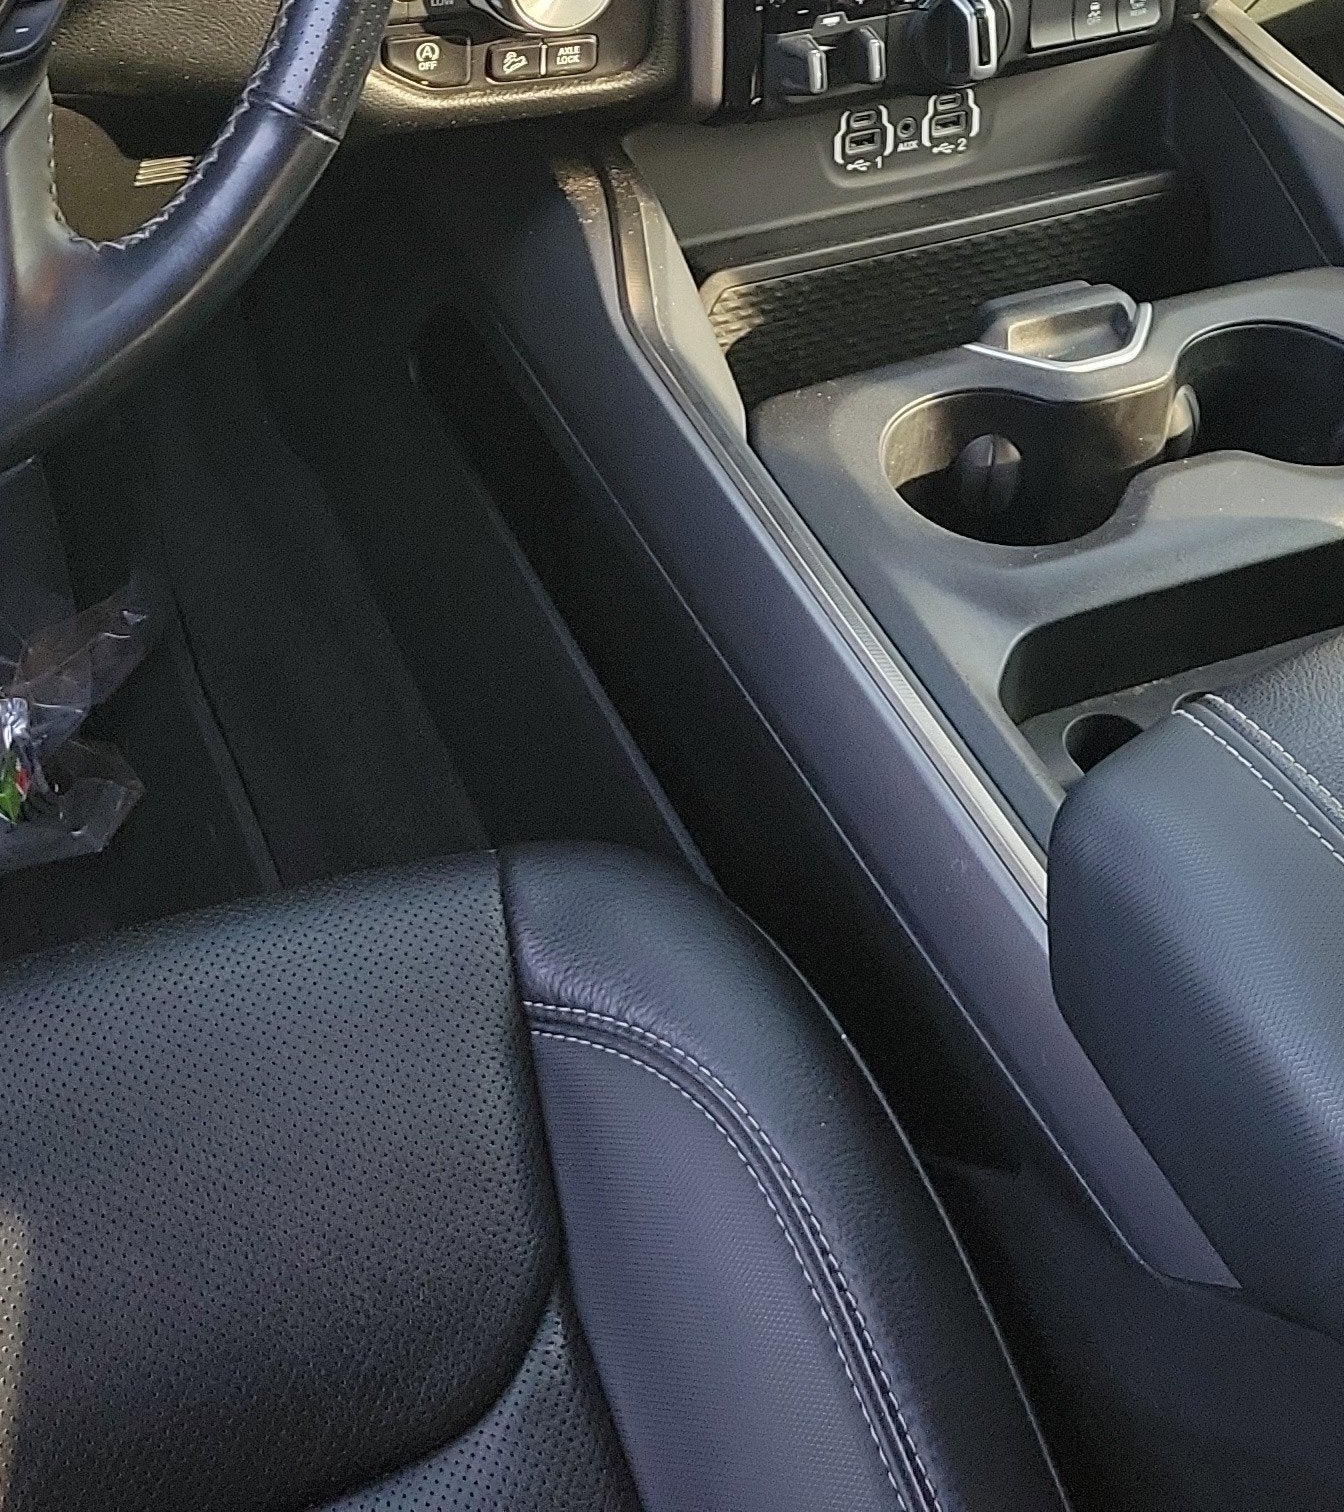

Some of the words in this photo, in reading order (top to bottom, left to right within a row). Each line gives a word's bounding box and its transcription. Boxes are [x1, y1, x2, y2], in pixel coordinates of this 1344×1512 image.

[558, 45, 582, 57] AXLE
[418, 60, 438, 71] OFF
[556, 54, 581, 66] LOCK
[896, 139, 919, 152] AUX
[956, 137, 967, 152] 2
[874, 155, 883, 169] 1
